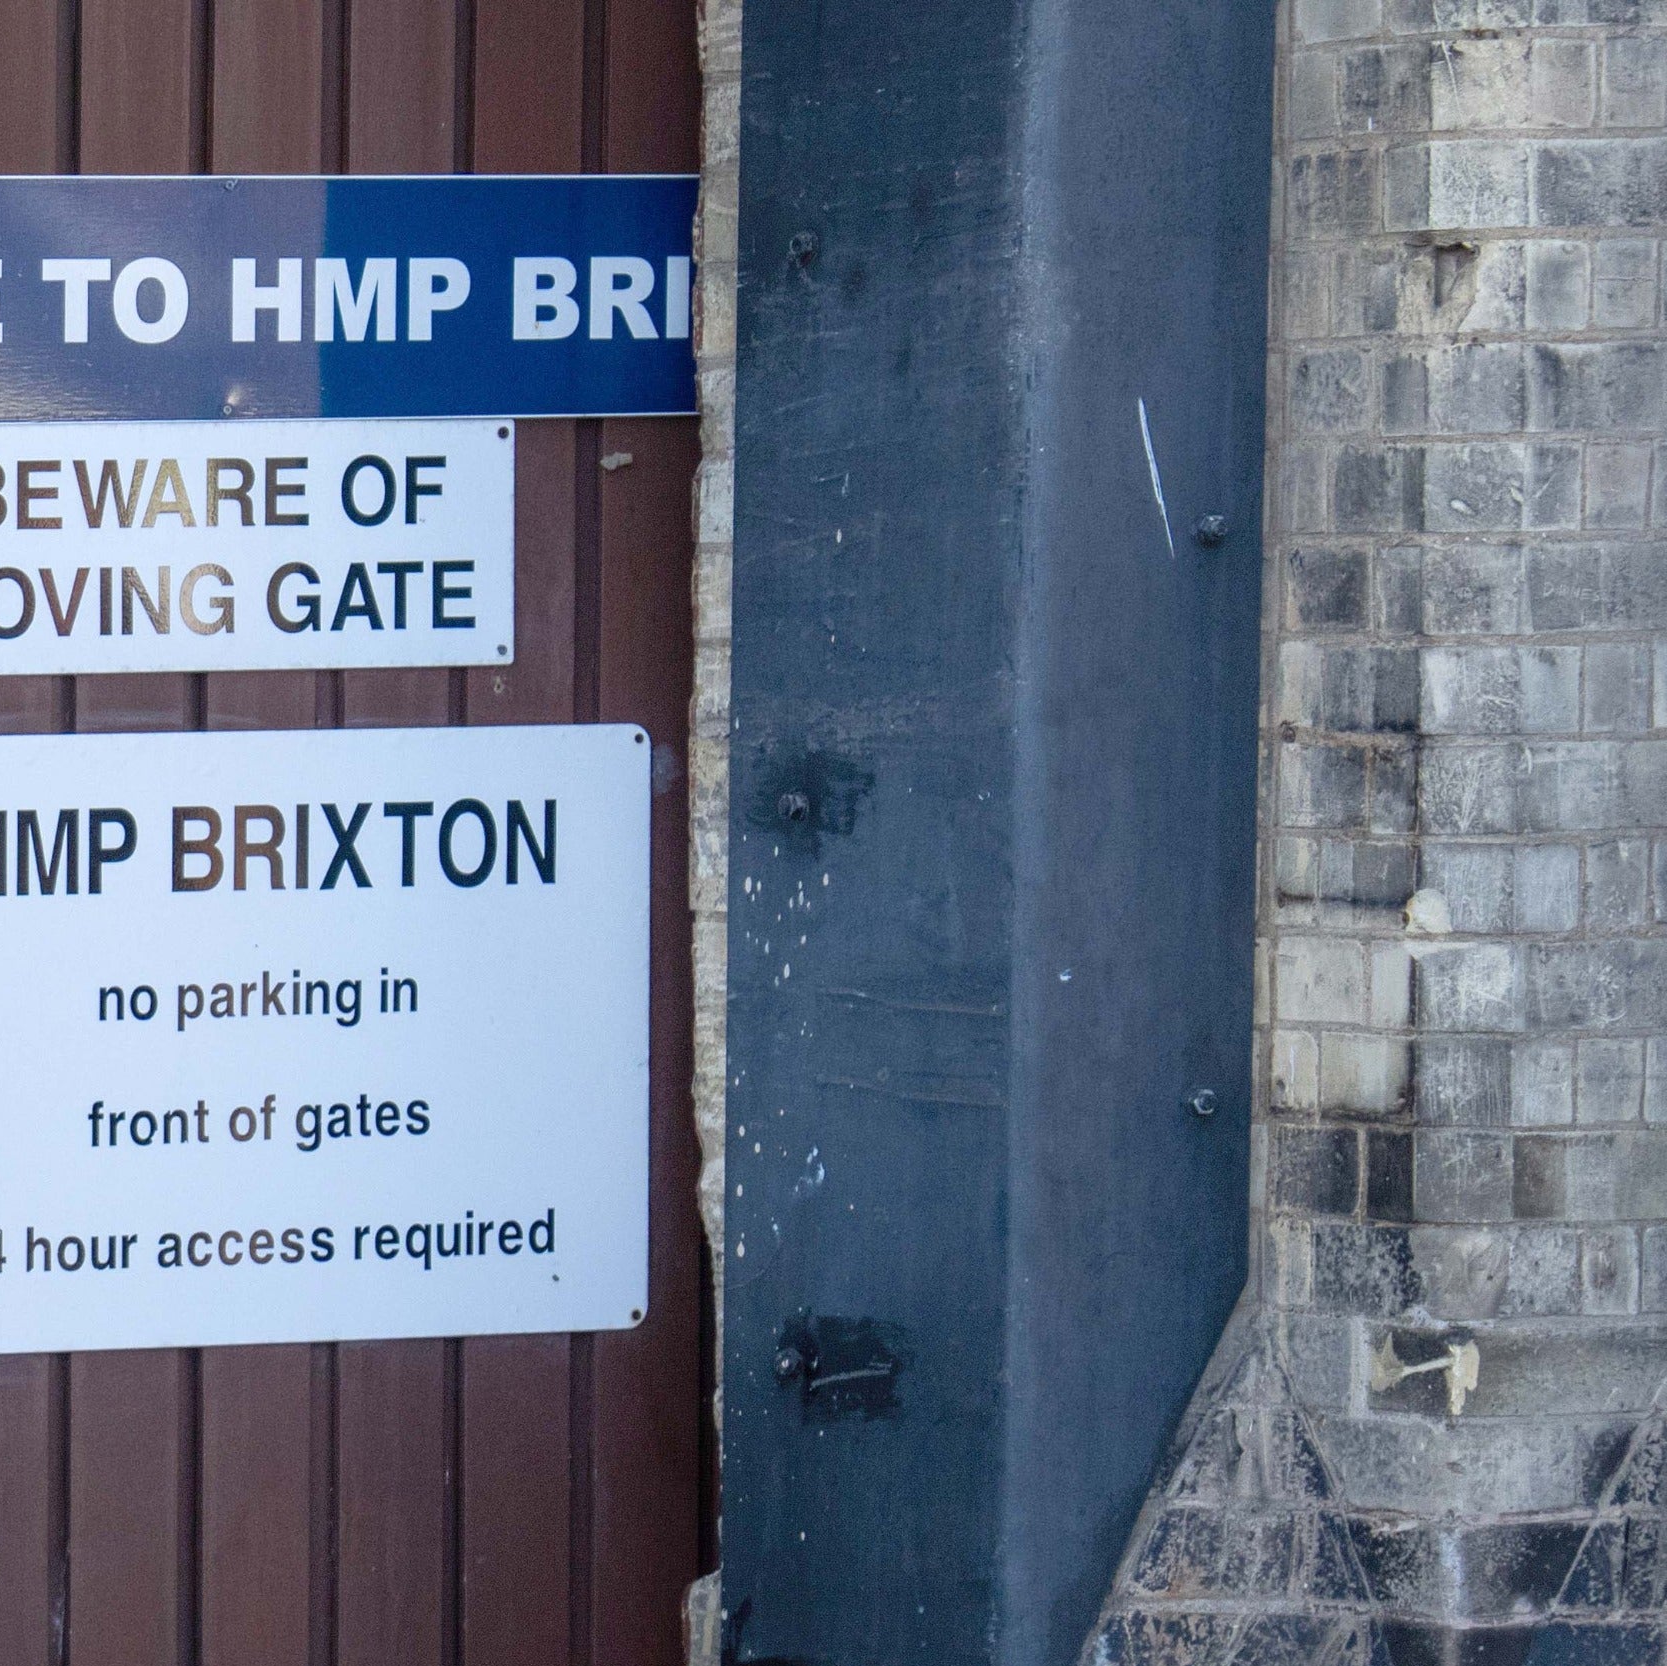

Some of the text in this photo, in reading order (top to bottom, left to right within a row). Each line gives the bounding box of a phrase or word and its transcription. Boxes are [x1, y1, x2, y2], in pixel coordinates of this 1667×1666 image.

[41, 256, 189, 344] TO
[227, 257, 471, 344] HMP
[512, 256, 690, 341] BRI
[341, 454, 447, 527] OF
[266, 559, 476, 634] GATE
[171, 797, 557, 893] BRIXTON
[99, 967, 418, 1032] no parking in
[87, 1093, 430, 1152] front of gates
[26, 1226, 138, 1273] hour
[157, 1226, 335, 1269] access
[354, 1208, 555, 1271] required
